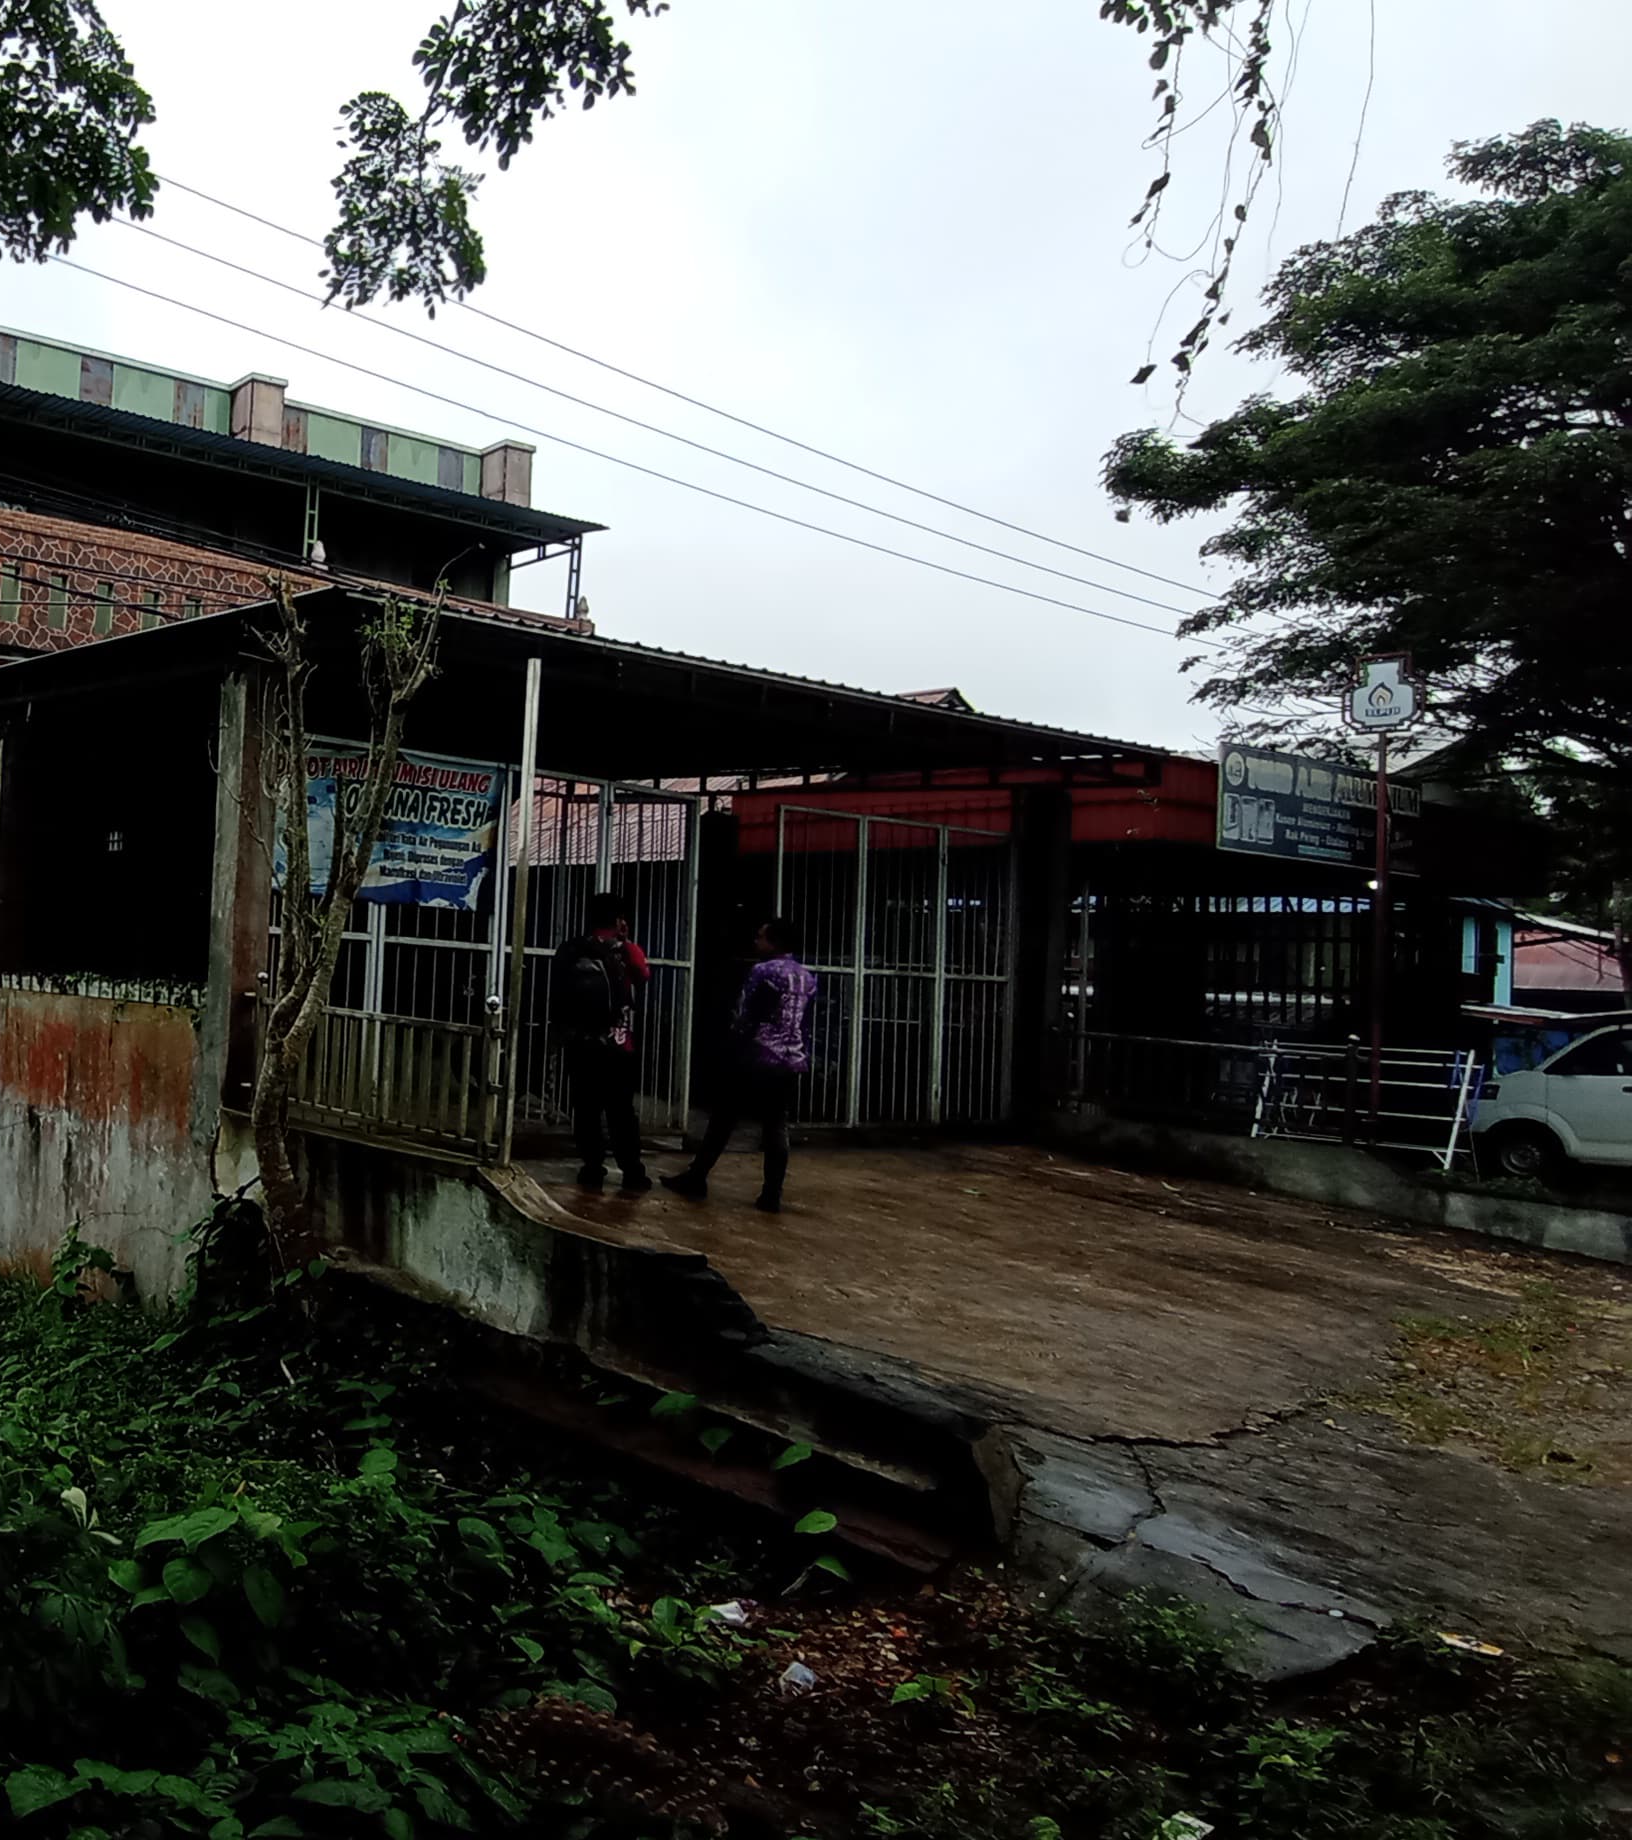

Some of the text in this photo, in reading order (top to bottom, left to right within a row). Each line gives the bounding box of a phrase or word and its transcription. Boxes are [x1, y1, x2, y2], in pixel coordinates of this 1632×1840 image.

[276, 754, 330, 777] DOT
[333, 757, 358, 779] AIR
[416, 766, 439, 788] ISI
[438, 768, 492, 794] ULANG
[424, 794, 491, 828] FRESH
